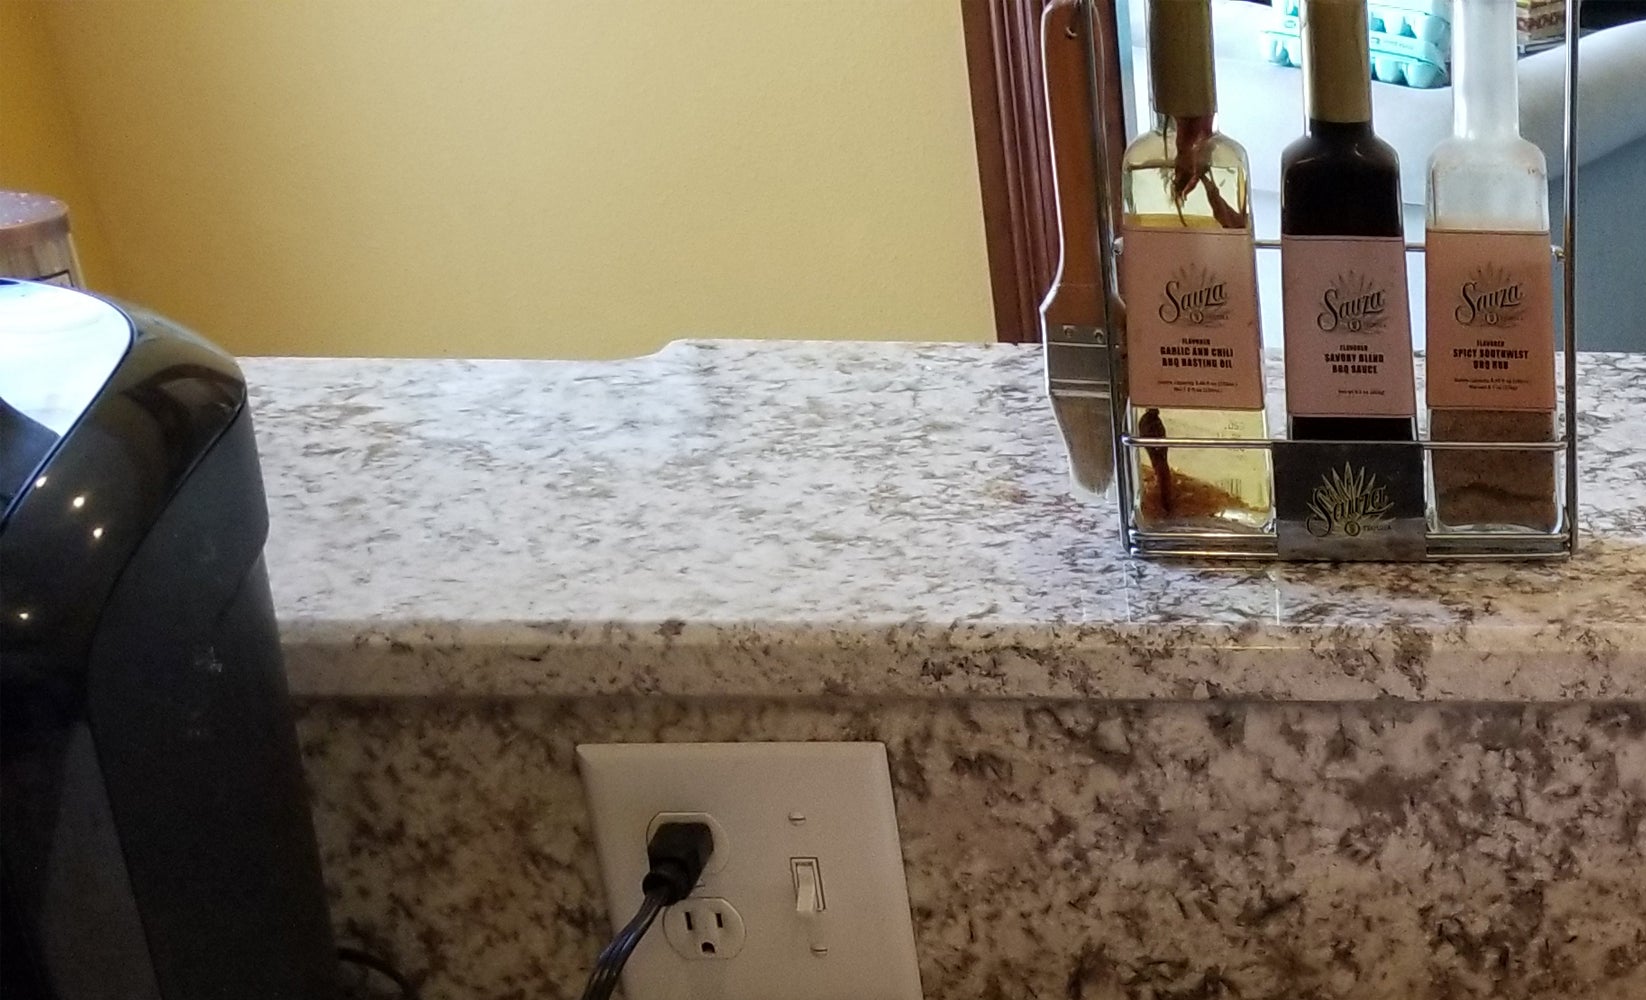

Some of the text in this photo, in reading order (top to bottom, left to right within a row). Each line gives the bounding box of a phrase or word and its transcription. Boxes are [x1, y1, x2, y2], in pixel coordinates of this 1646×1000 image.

[1159, 281, 1226, 324] Sauza
[1455, 282, 1522, 326] Sauza
[1317, 289, 1386, 332] Sauza
[1160, 346, 1234, 358] GARLIC AND CHILI
[1324, 353, 1384, 363] SAVORY BLEND
[1453, 348, 1529, 359] SPICY SOUTHWEST
[1162, 357, 1232, 369] BBQ BASTING OIL
[1332, 364, 1378, 374] BBQ SAUCE
[1473, 360, 1509, 370] BBQ RUB
[1306, 487, 1388, 537] Sauza
